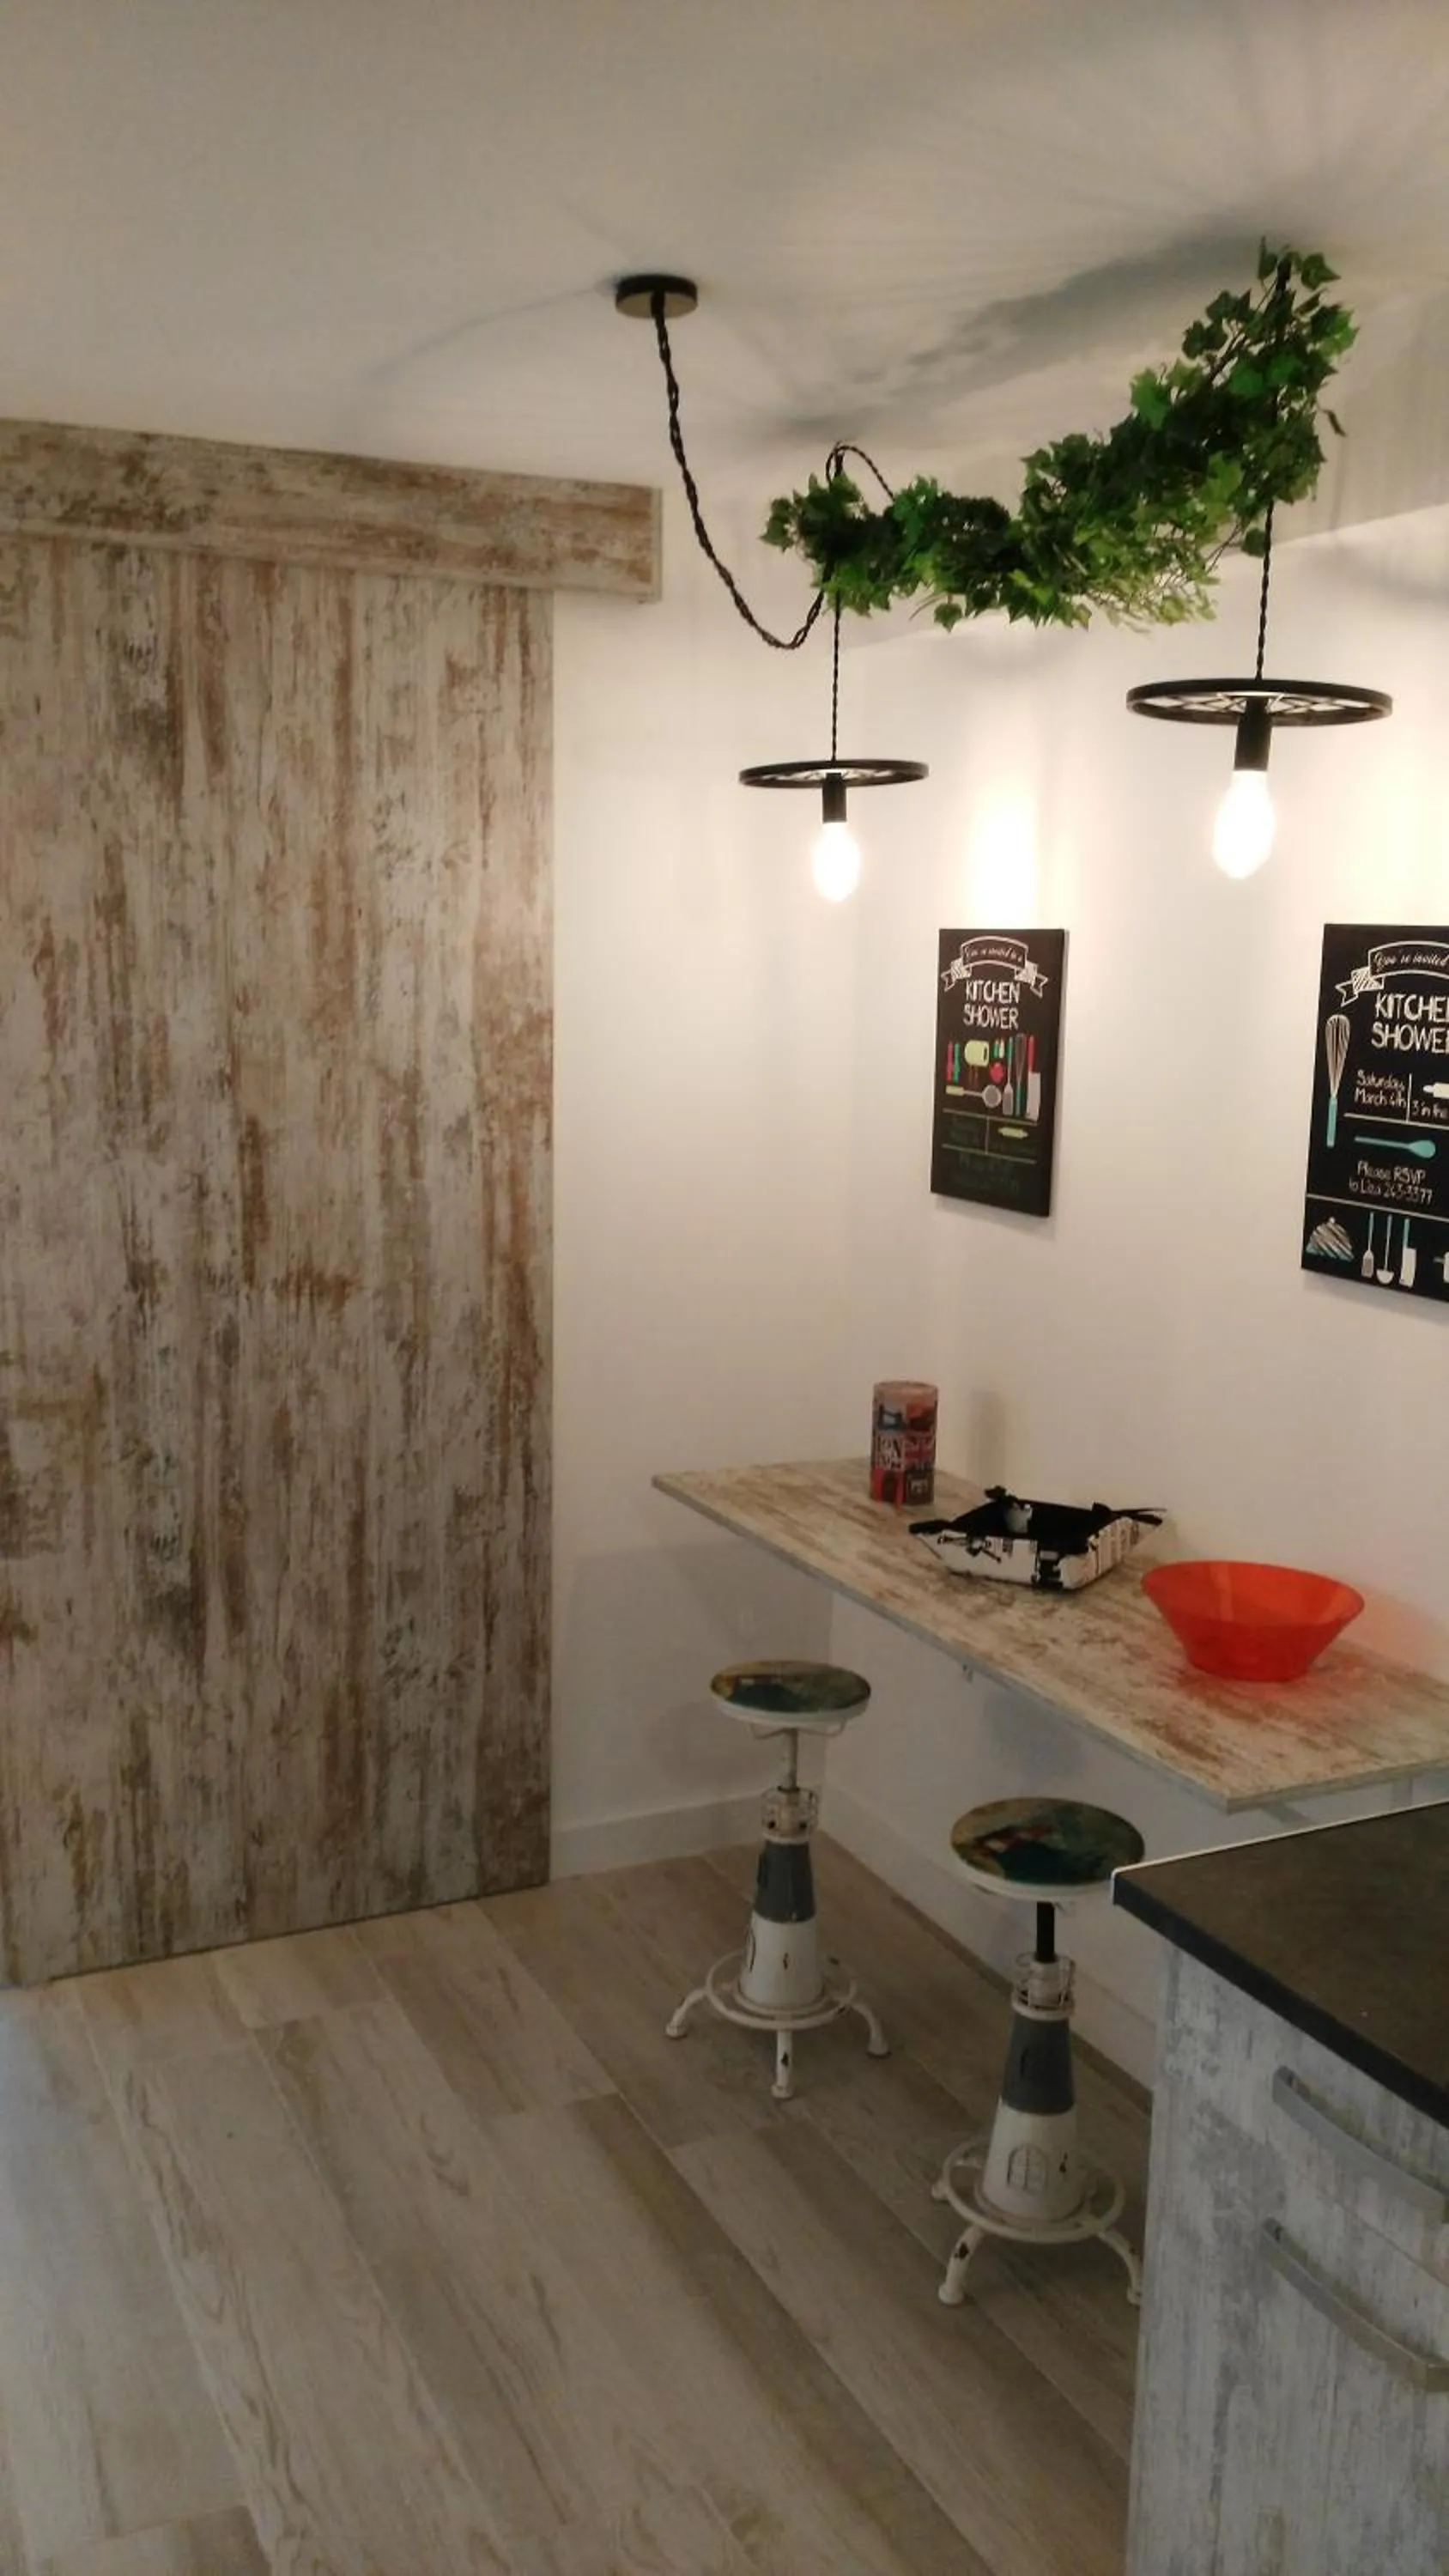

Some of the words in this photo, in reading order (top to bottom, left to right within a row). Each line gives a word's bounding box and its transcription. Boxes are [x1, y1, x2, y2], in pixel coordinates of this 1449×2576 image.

[965, 980, 1021, 1004] KITCHEN
[963, 1002, 1019, 1030] SHOWER
[1354, 1086, 1388, 1107] March
[1357, 1160, 1391, 1182] Please
[1393, 1166, 1427, 1185] RSVP
